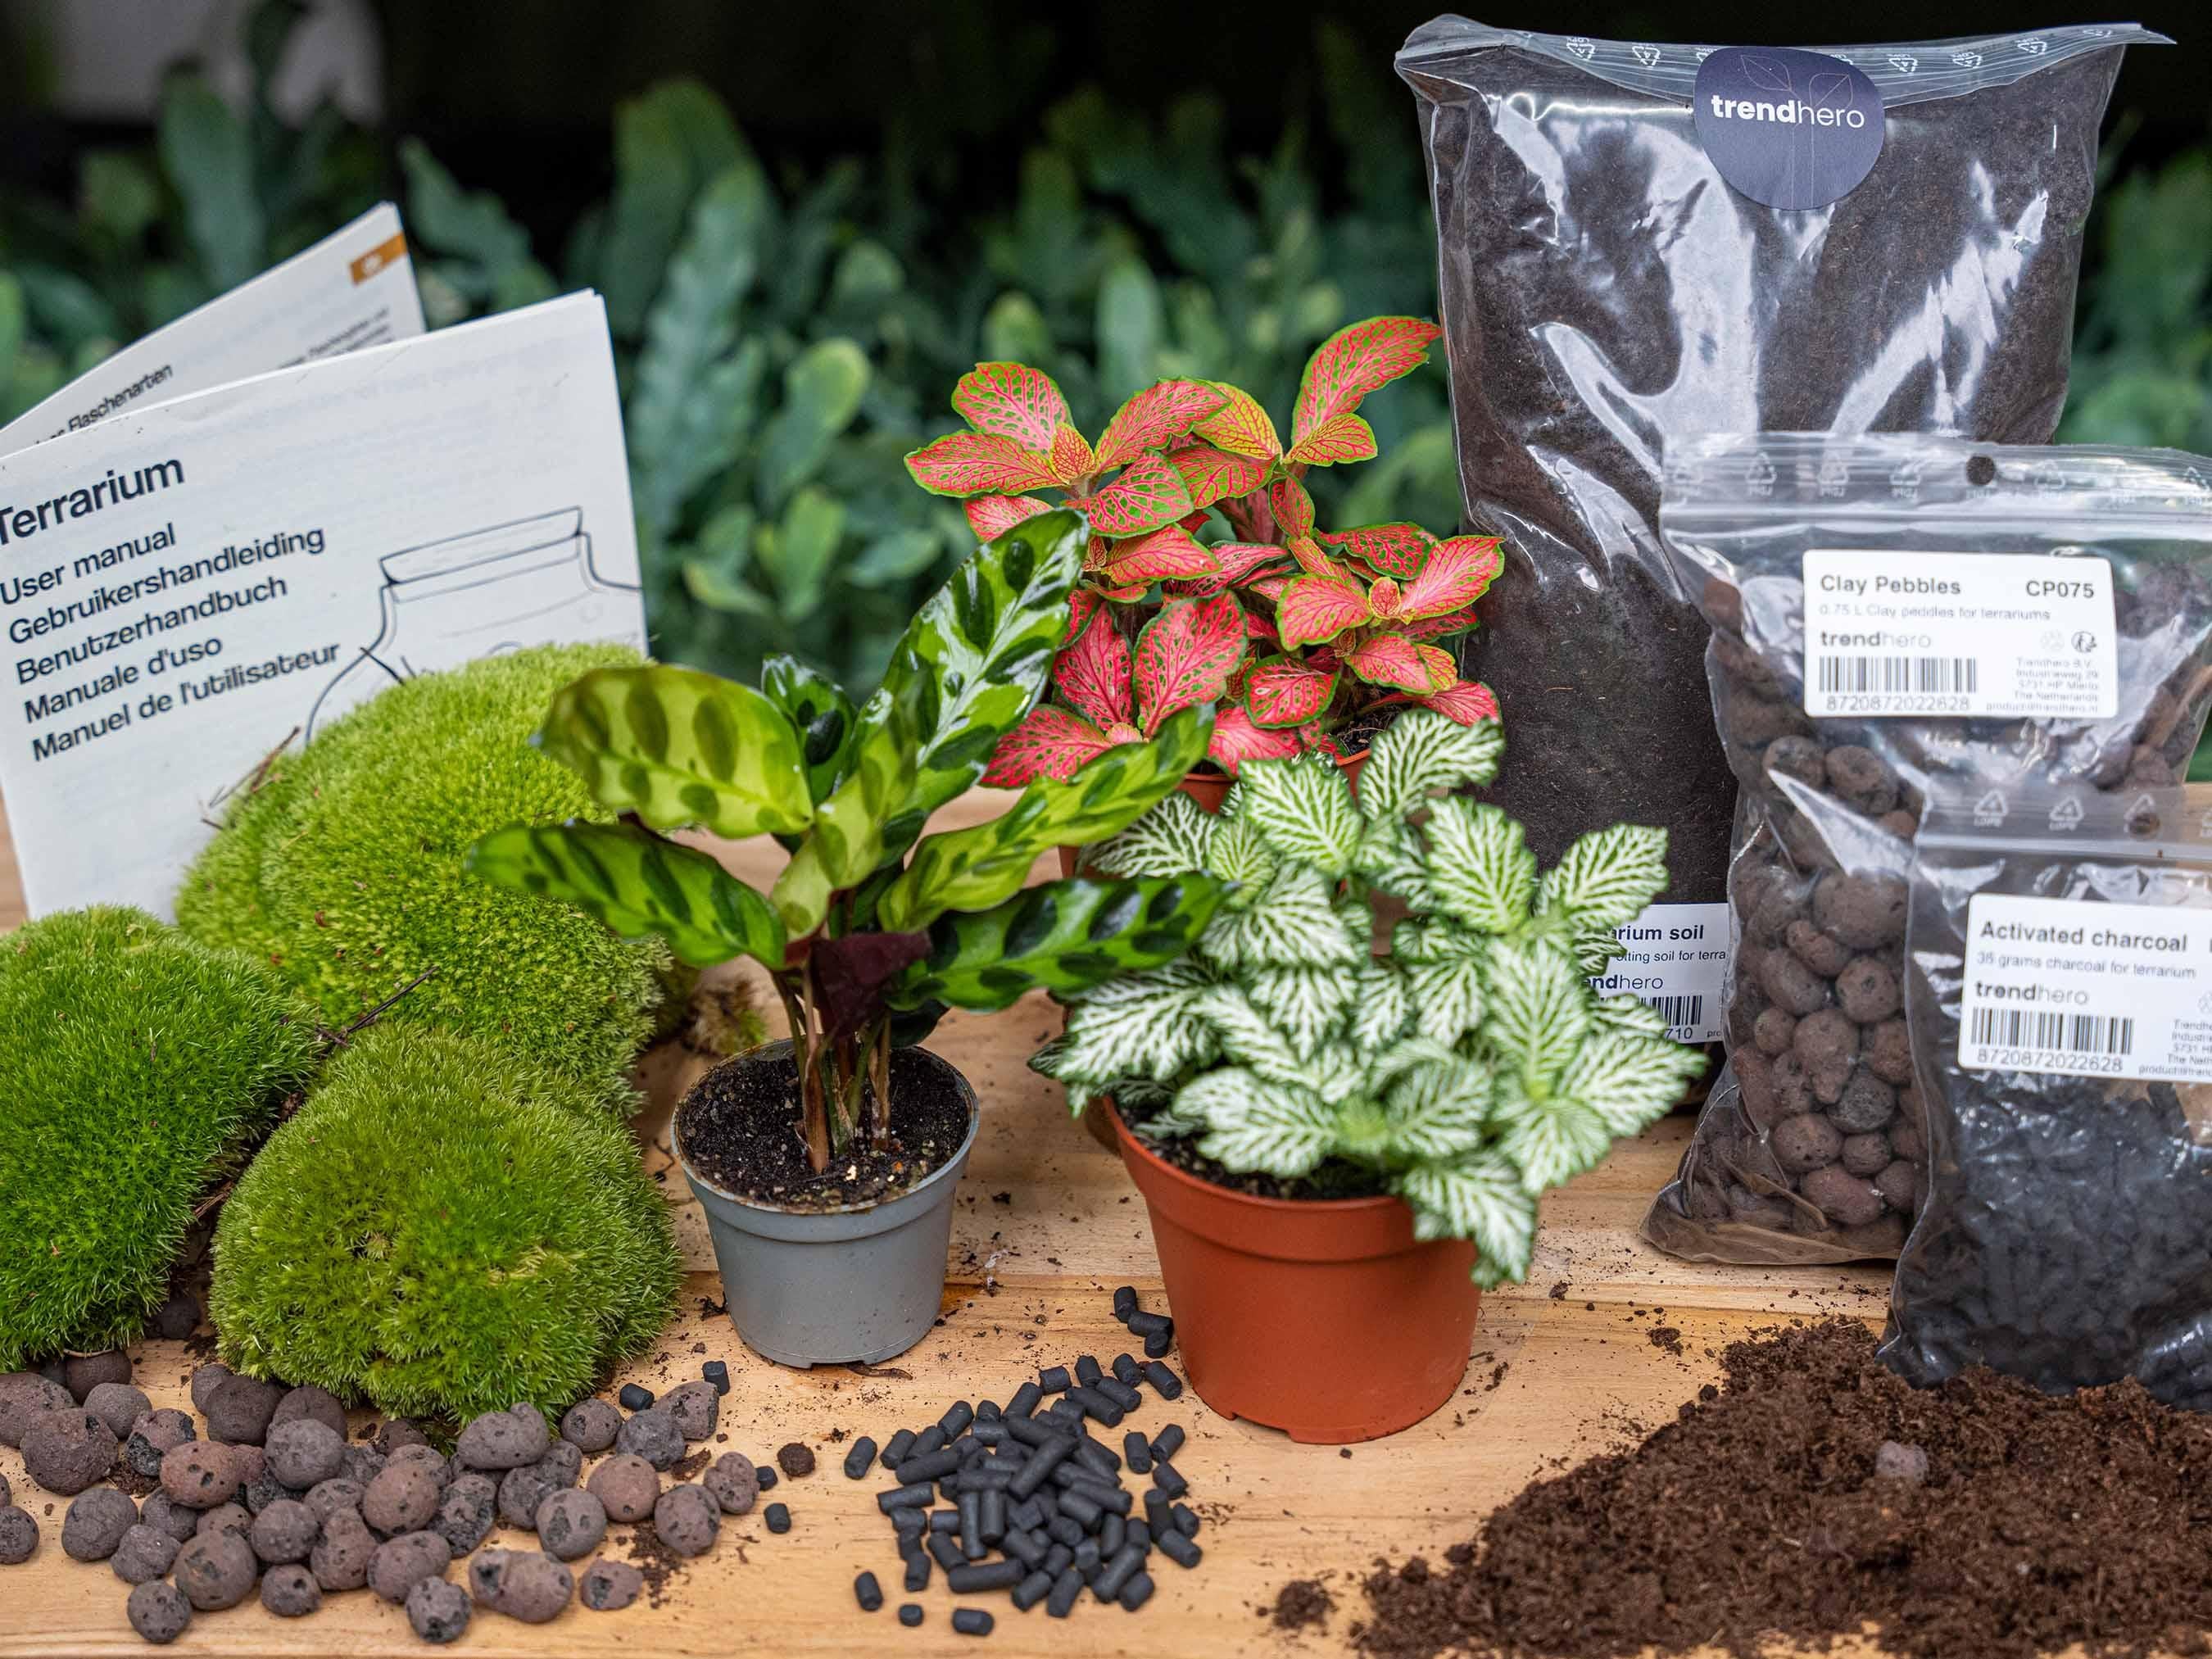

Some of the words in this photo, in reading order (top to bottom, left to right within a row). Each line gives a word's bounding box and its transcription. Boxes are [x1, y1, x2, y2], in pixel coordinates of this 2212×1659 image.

[1711, 94, 1865, 129] trendhero
[0, 459, 185, 546] Terrarium
[0, 565, 66, 605] User
[73, 522, 176, 578] manual
[9, 528, 326, 645] Gebruikershandleiding
[1820, 575, 1867, 596] Clay
[1875, 575, 1961, 595] Pebbles
[2026, 580, 2095, 598] CP075
[1866, 605, 1897, 619] Clay
[1959, 606, 1978, 617] for
[16, 576, 288, 685] Benutzerhandbuch
[1820, 630, 1932, 648] trendhero
[24, 665, 139, 724] Manuale
[147, 637, 223, 675] d'uso
[32, 704, 132, 762] Manuel
[138, 694, 174, 720] de
[179, 643, 340, 705] l'utilisateur
[1669, 924, 1704, 941] soil
[1979, 921, 2084, 945] Activated
[2092, 930, 2188, 952] charcoal
[1653, 950, 1675, 962] soil
[1679, 950, 1695, 961] for
[1698, 950, 1726, 961] terra
[1998, 955, 2042, 969] grams
[2046, 957, 2105, 972] charcoal
[2110, 960, 2129, 974] for
[2133, 963, 2196, 979] terrarium
[1974, 981, 2090, 1005] trendhero
[1977, 1048, 2124, 1073] 8720872022628
